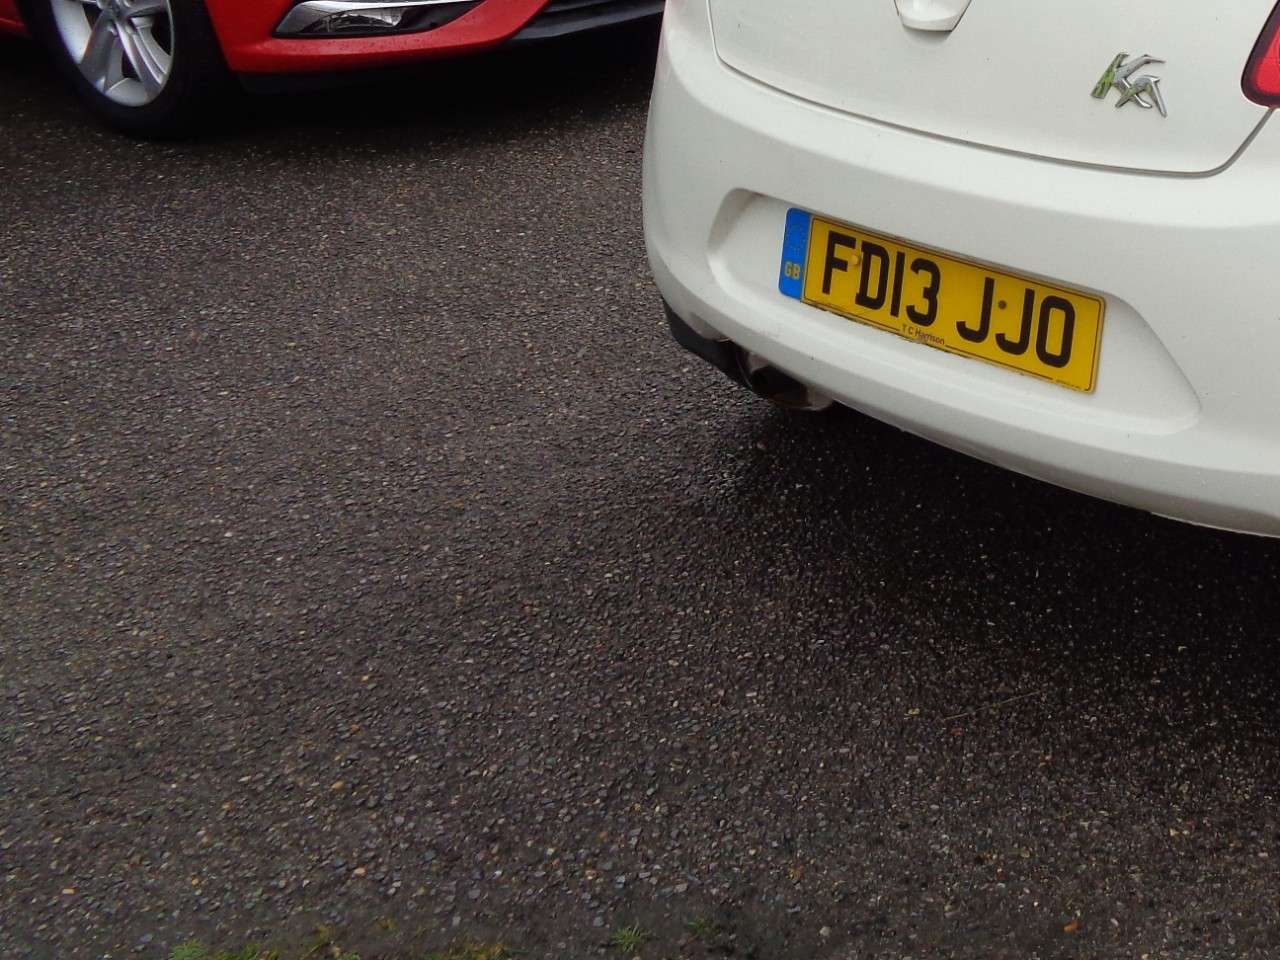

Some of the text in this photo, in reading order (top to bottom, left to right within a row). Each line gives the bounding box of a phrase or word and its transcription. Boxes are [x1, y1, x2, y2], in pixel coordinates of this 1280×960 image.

[784, 261, 801, 281] GB
[822, 230, 1077, 369] FD13 JJO
